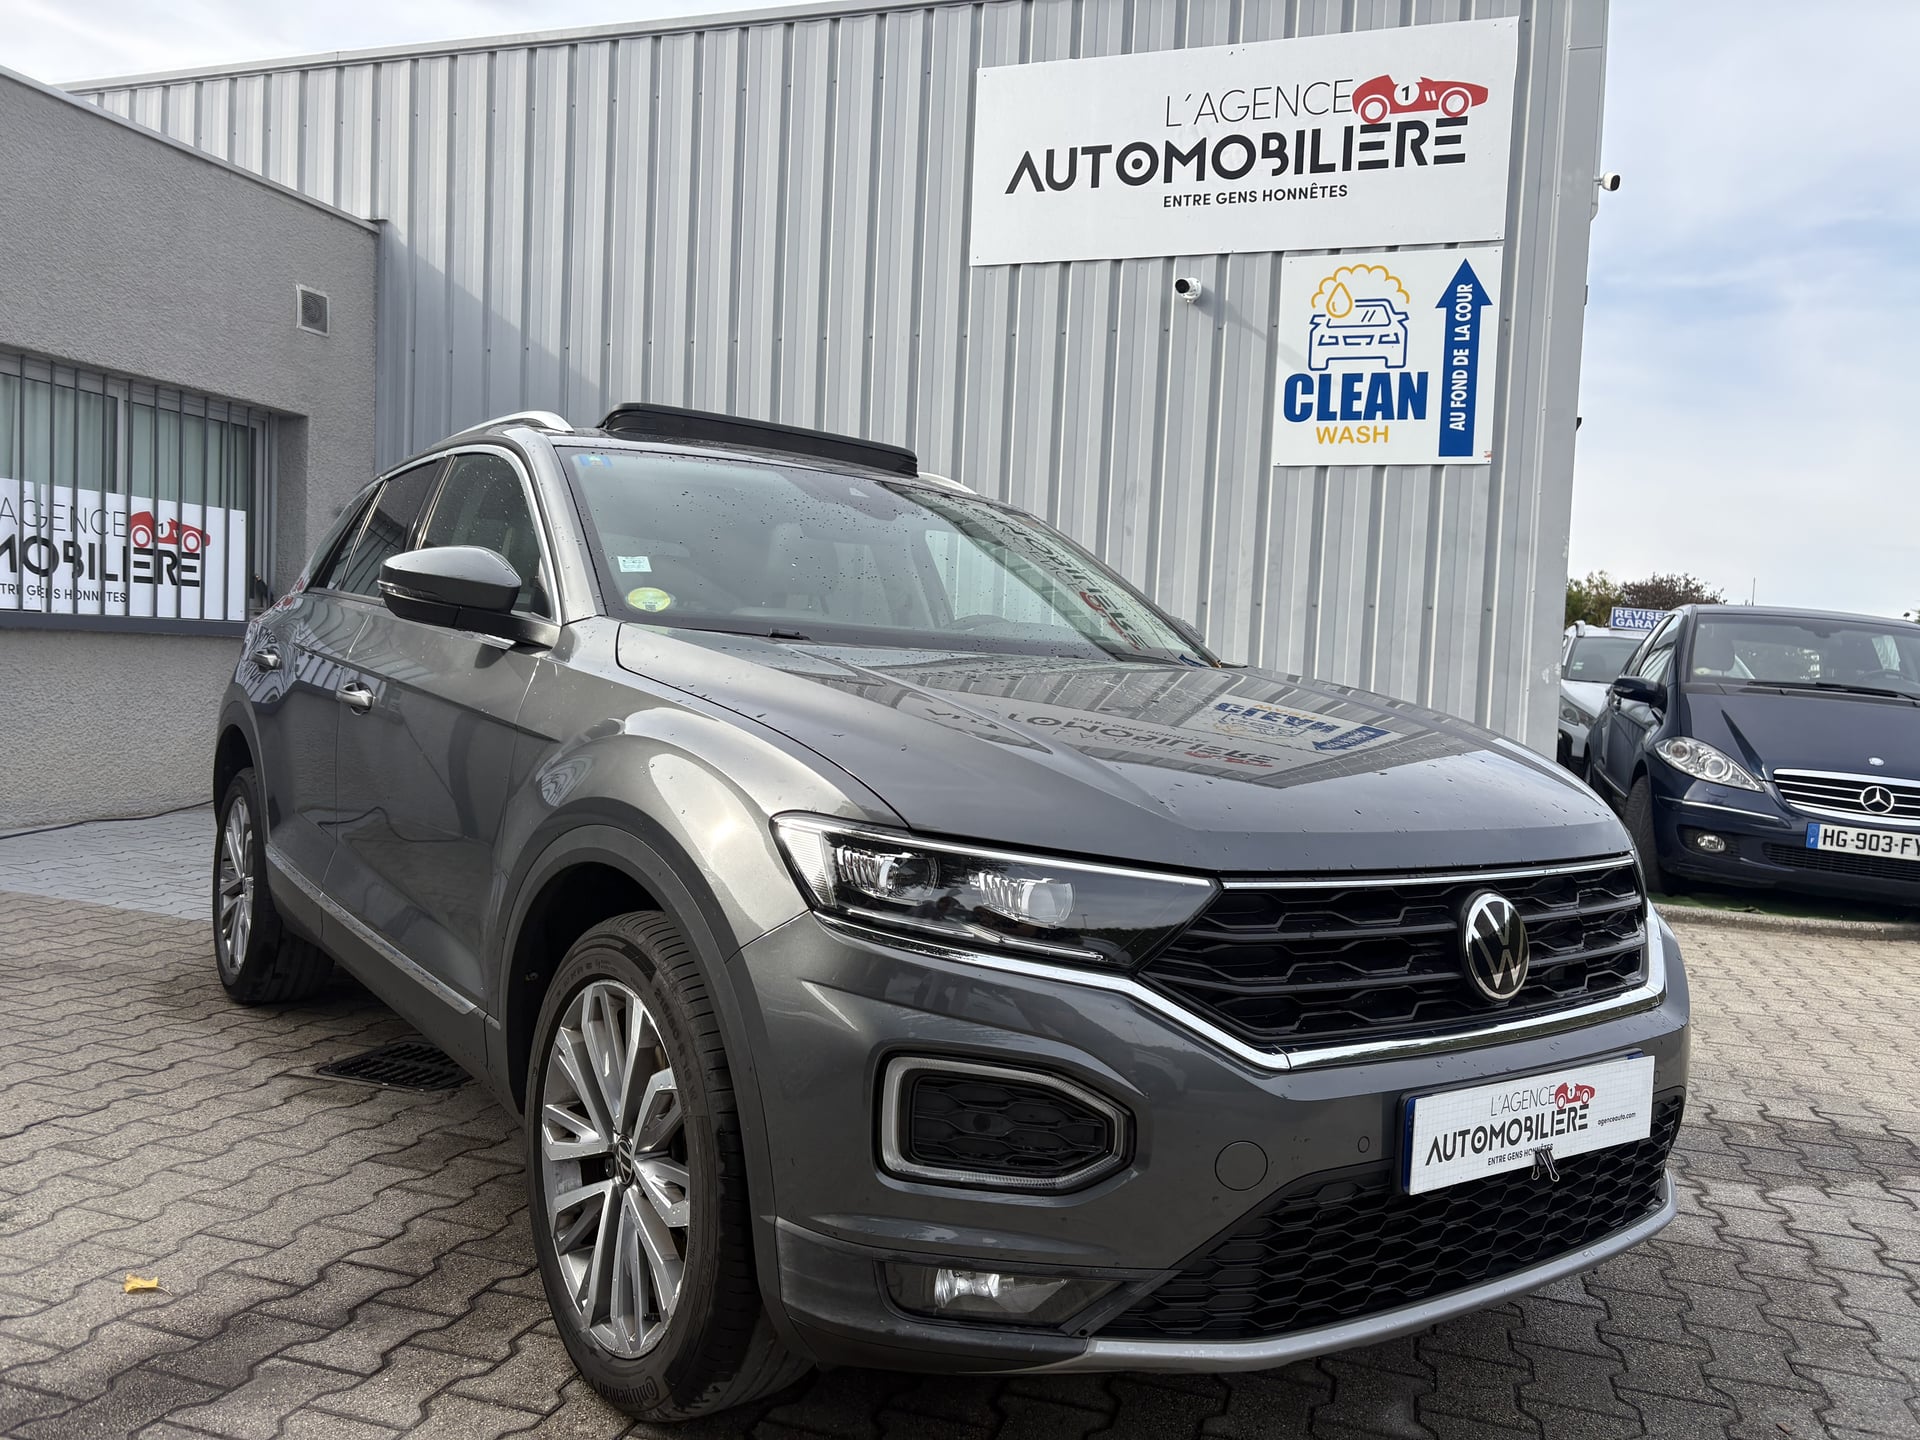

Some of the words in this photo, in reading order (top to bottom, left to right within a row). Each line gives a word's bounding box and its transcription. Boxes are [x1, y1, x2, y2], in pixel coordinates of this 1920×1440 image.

[1165, 79, 1354, 127] L'AGENCE
[1400, 85, 1411, 102] 1
[1005, 116, 1469, 194] AUTOMOBILIERE
[1163, 193, 1211, 208] ENTRE
[1215, 188, 1258, 205] GENS
[1262, 182, 1348, 202] HONNÊTES
[1455, 283, 1473, 322] COUR
[1454, 324, 1471, 341] LA
[1453, 348, 1469, 366] DE
[1284, 371, 1429, 422] CLEAN
[1451, 369, 1468, 408] FOND
[1315, 425, 1389, 444] WASH
[1449, 412, 1466, 431] AU
[1490, 1085, 1556, 1117] L'AGENCE
[1597, 1112, 1636, 1127] agenceauto.com
[1425, 1104, 1589, 1166] AUTOMOBILIERE
[1487, 1154, 1506, 1165] ENTRE
[1507, 1150, 1523, 1161] GENS
